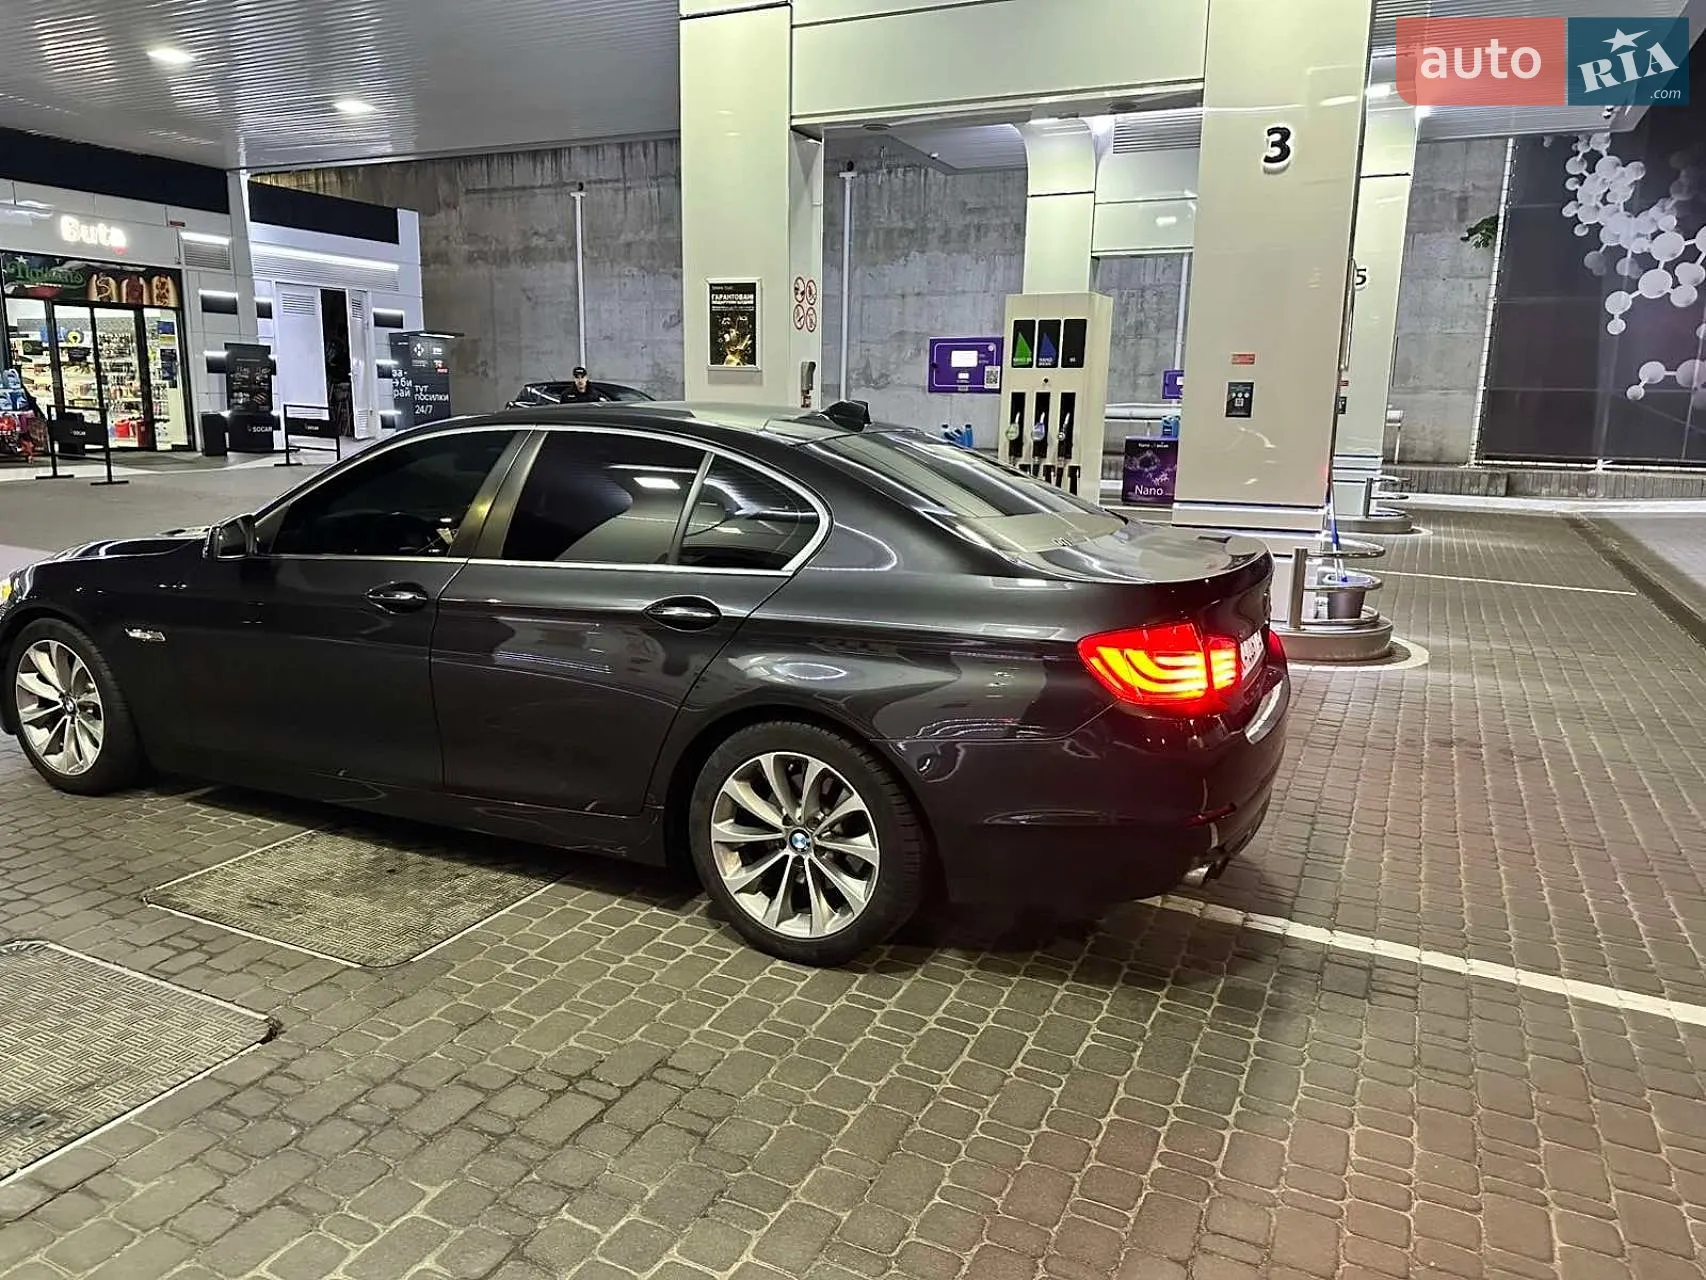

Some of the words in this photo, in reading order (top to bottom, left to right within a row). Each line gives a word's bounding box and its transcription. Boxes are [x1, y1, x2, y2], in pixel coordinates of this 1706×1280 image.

[1263, 126, 1292, 164] 3
[1355, 267, 1368, 286] 5
[393, 387, 411, 399] рай
[414, 385, 429, 394] тут
[414, 393, 449, 402] посилки
[415, 404, 433, 415] 24/7
[1134, 485, 1164, 496] Nano
